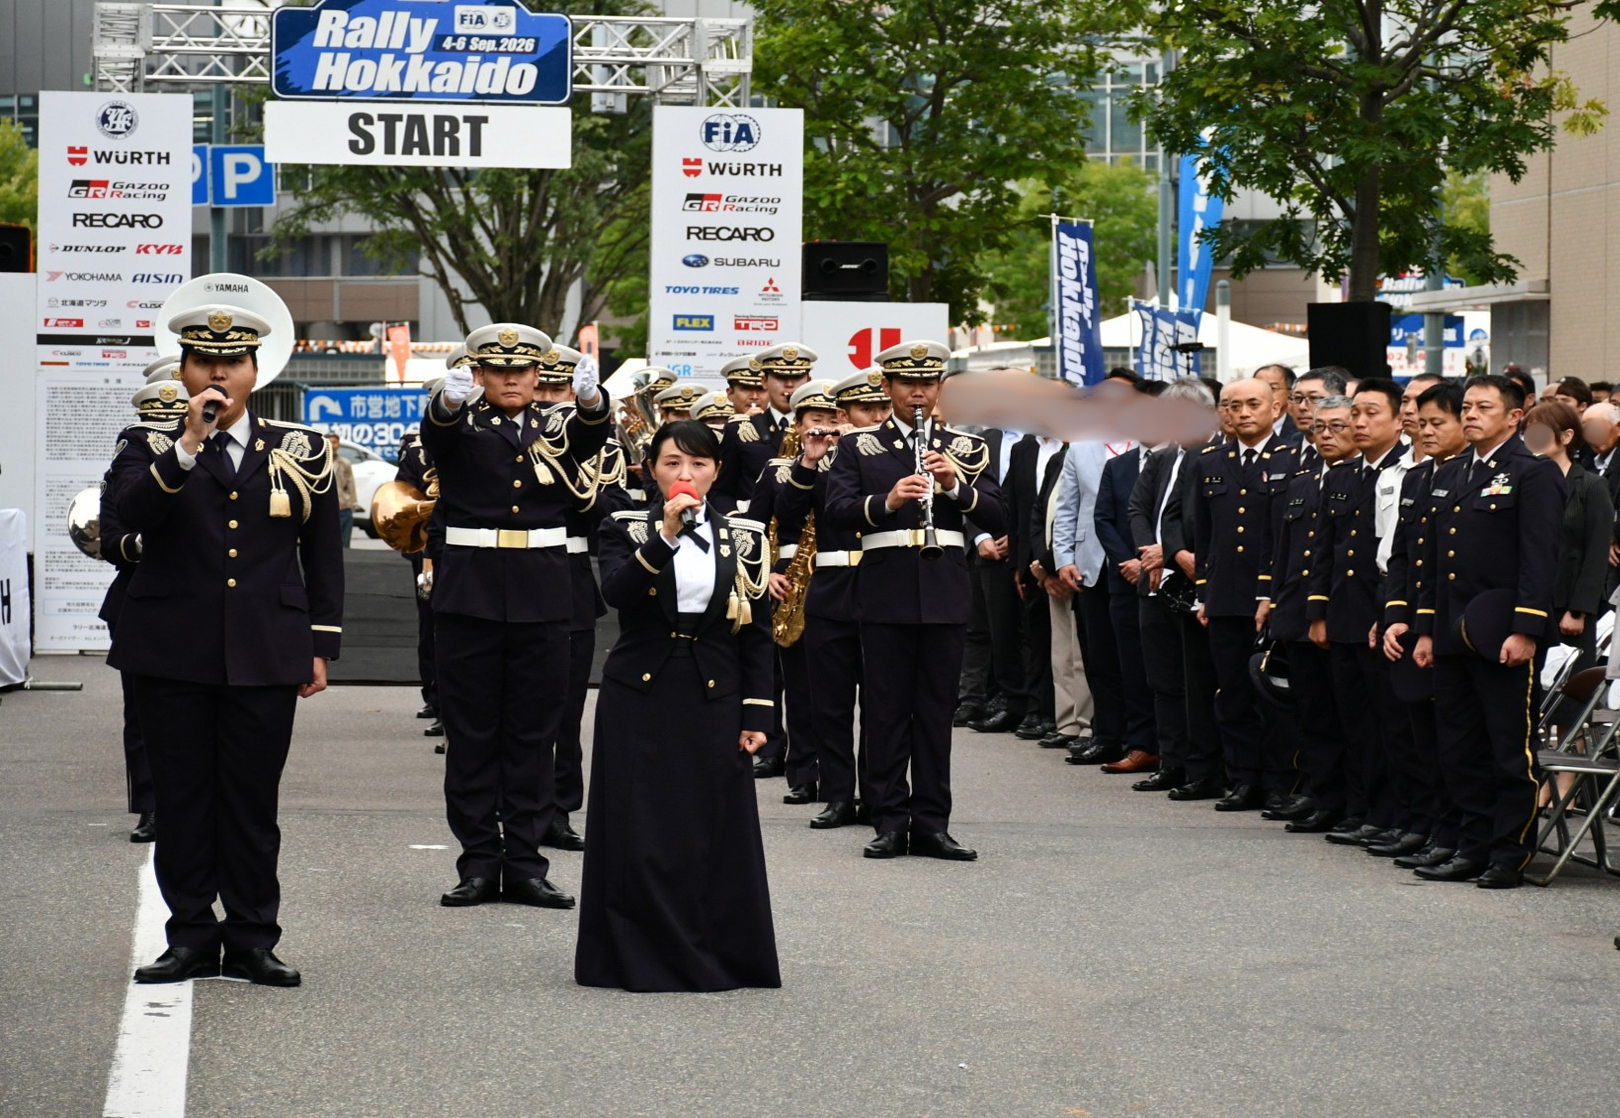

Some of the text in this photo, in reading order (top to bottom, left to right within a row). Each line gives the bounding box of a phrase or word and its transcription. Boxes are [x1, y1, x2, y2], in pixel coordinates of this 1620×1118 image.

[313, 9, 439, 54] Rally
[442, 36, 467, 51] 4-6
[312, 52, 539, 96] Hokkaido
[348, 112, 489, 157] START
[222, 153, 262, 199] P
[68, 183, 109, 198] GR
[112, 181, 170, 191] GAZOO
[110, 190, 167, 202] Racing
[725, 195, 781, 204] GAZOO
[682, 198, 722, 212] GR
[723, 204, 778, 215] Racing
[72, 213, 163, 229] RECARO
[686, 226, 775, 242] RECARO
[61, 245, 126, 253] DUNLOP
[135, 244, 183, 255] KYB
[714, 258, 781, 268] SUBARU
[65, 272, 122, 282] YOKOHAMA
[132, 273, 183, 284] AISIN
[214, 283, 249, 293] YAMAHA
[665, 285, 740, 295] TOYO TIRES
[676, 317, 711, 328] FLEX
